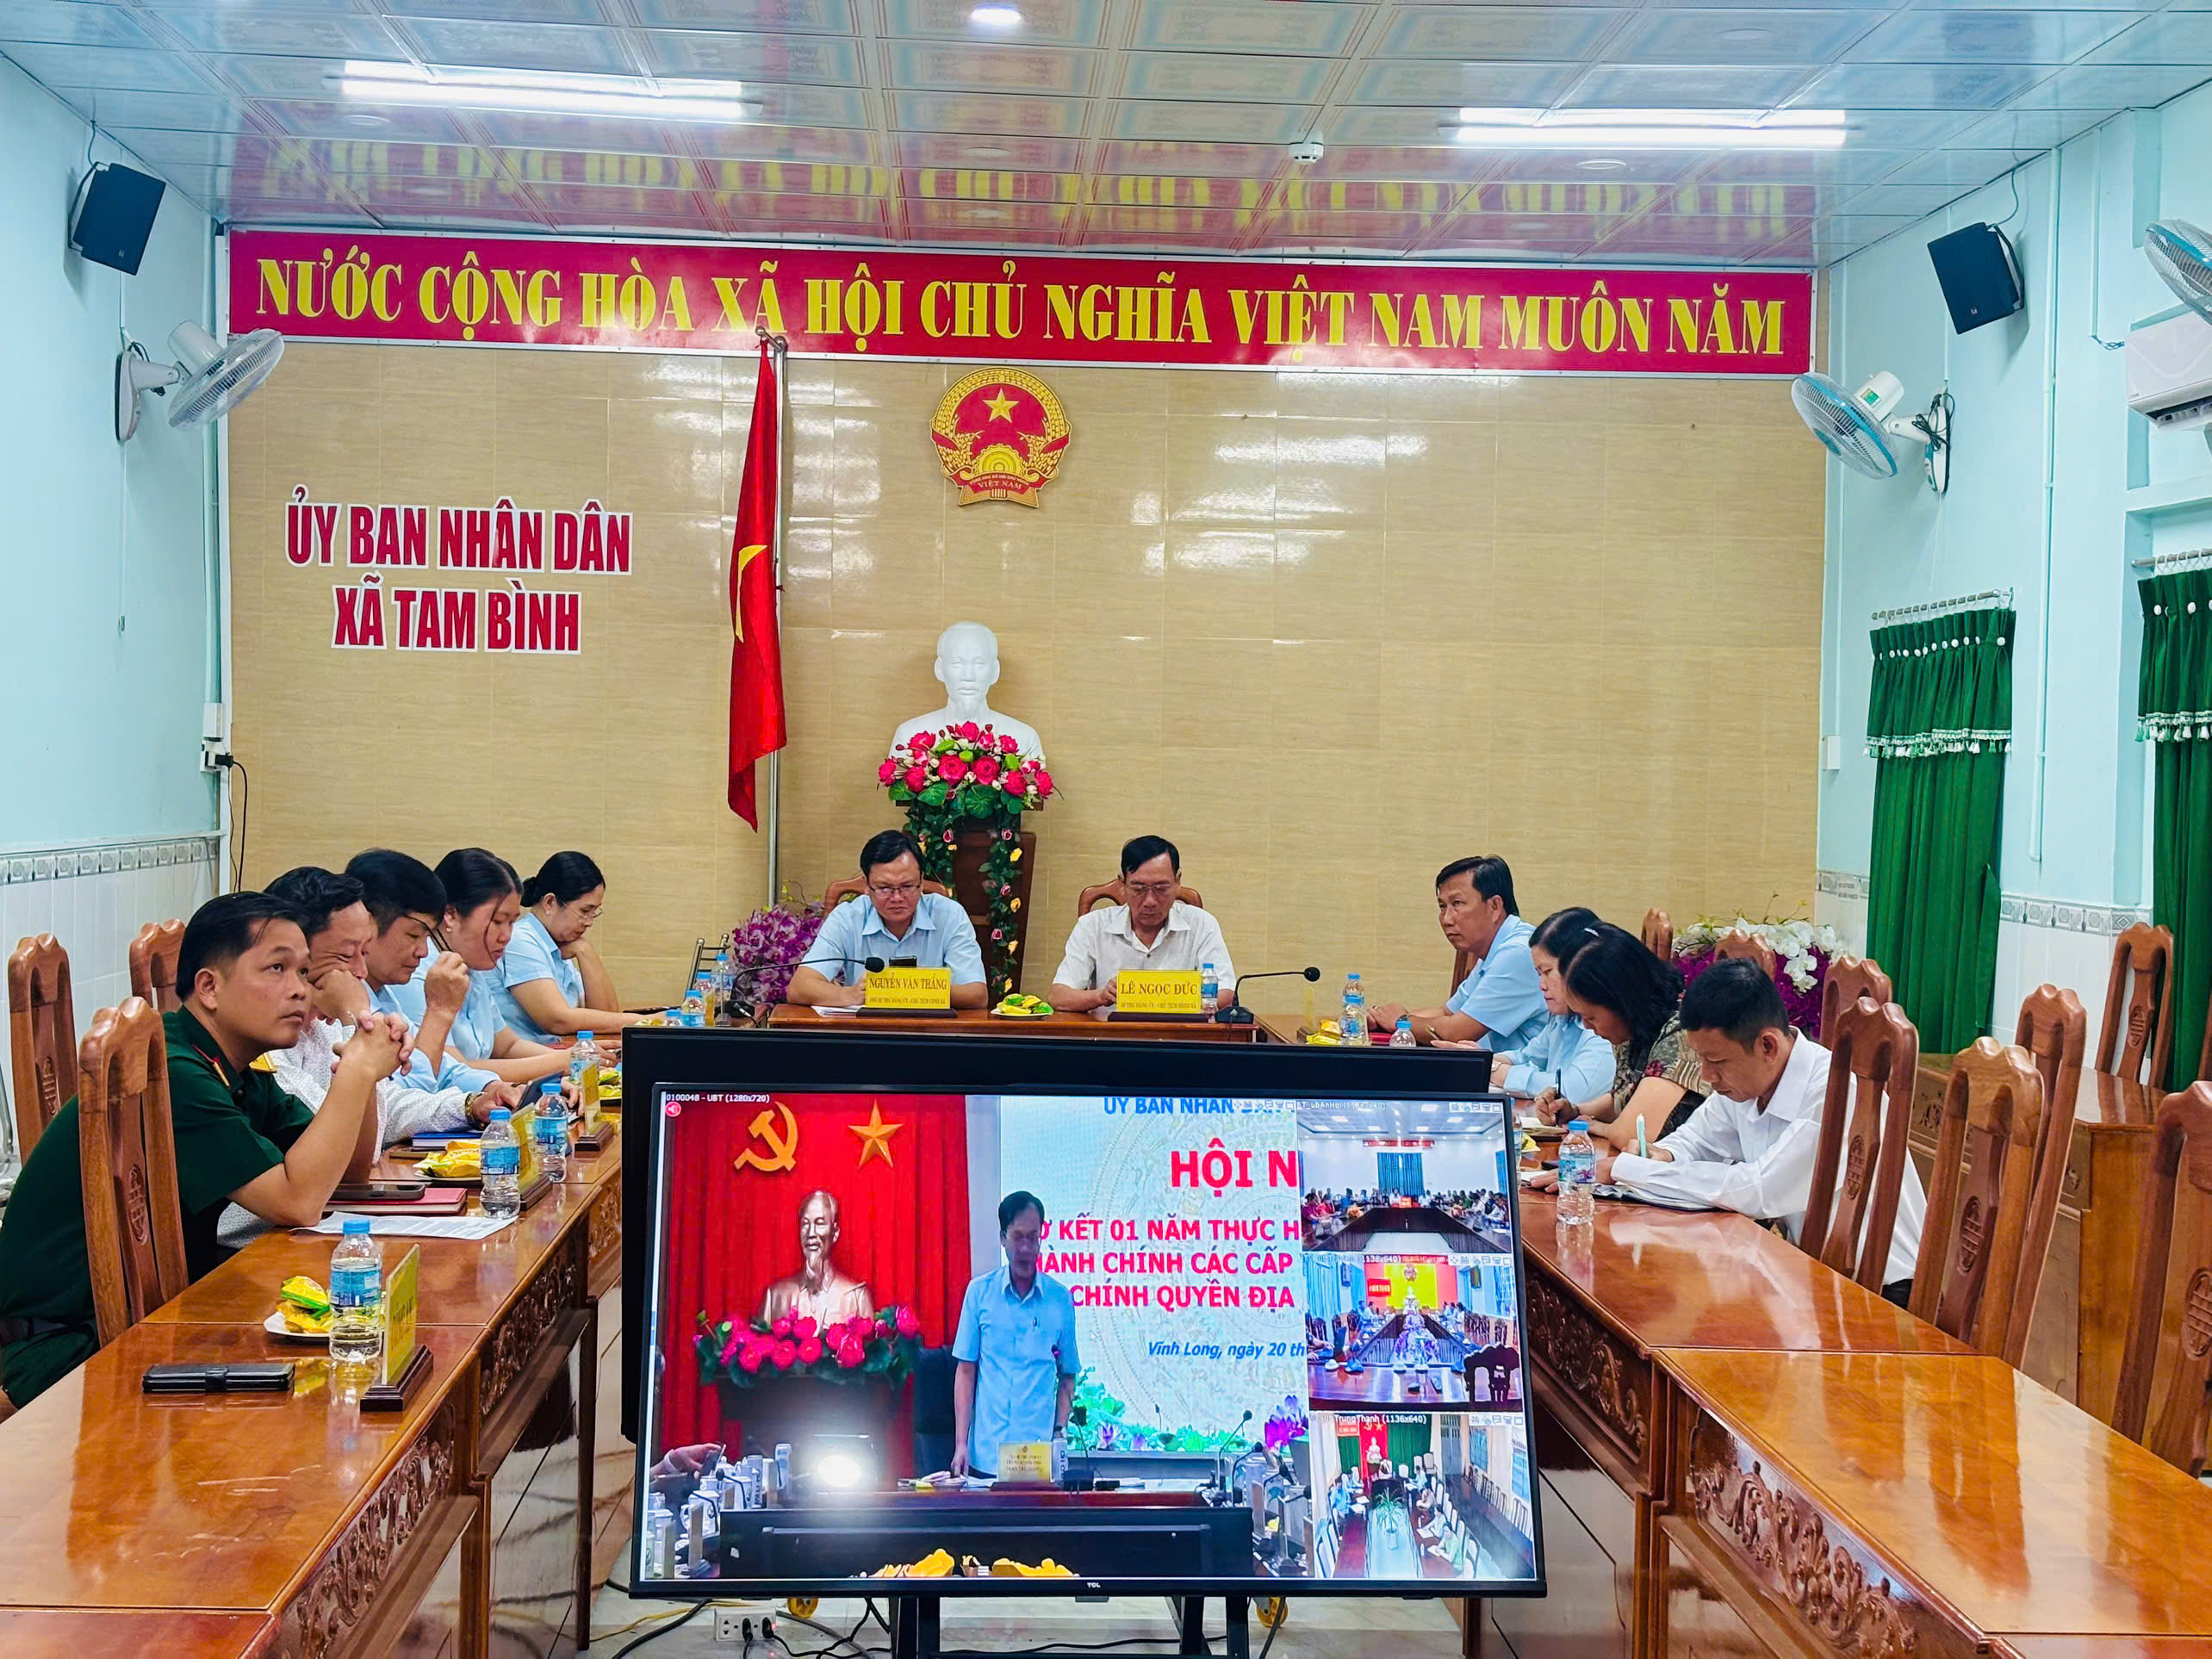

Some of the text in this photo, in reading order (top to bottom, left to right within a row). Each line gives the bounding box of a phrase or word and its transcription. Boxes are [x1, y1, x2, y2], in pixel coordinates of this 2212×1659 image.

[257, 245, 1786, 364] NƯỚC CỘNG HÒA XÃ HỘI CHỦ NGHĨA VIỆT NAM MUÔN NĂM
[1003, 480, 1022, 489] NAM
[286, 486, 631, 573] ỦY BAN NHÂN DÂN
[333, 574, 580, 652] XÃ TAM BÌNH
[1121, 980, 1135, 994] LÊ
[1139, 983, 1171, 997] NGỌC
[1135, 1097, 1174, 1114] BAN
[1171, 1137, 1253, 1197] HỘI
[1059, 1212, 1103, 1240] KẾT
[1110, 1220, 1139, 1241] 01
[1147, 1213, 1201, 1240] NĂM
[1208, 1215, 1276, 1246] THỰC
[1103, 1245, 1183, 1274] CHÍNH
[1190, 1245, 1239, 1274] CÁC
[1360, 1255, 1401, 1264] 1136x640)
[1070, 1278, 1295, 1313] CHÍNH QUYỀN ĐỊA
[1148, 1340, 1180, 1357] Vĩnh
[1184, 1342, 1222, 1360] Long,
[1227, 1341, 1264, 1360] ngày
[1267, 1342, 1287, 1357] 20
[1382, 1414, 1426, 1424] (1136x640)
